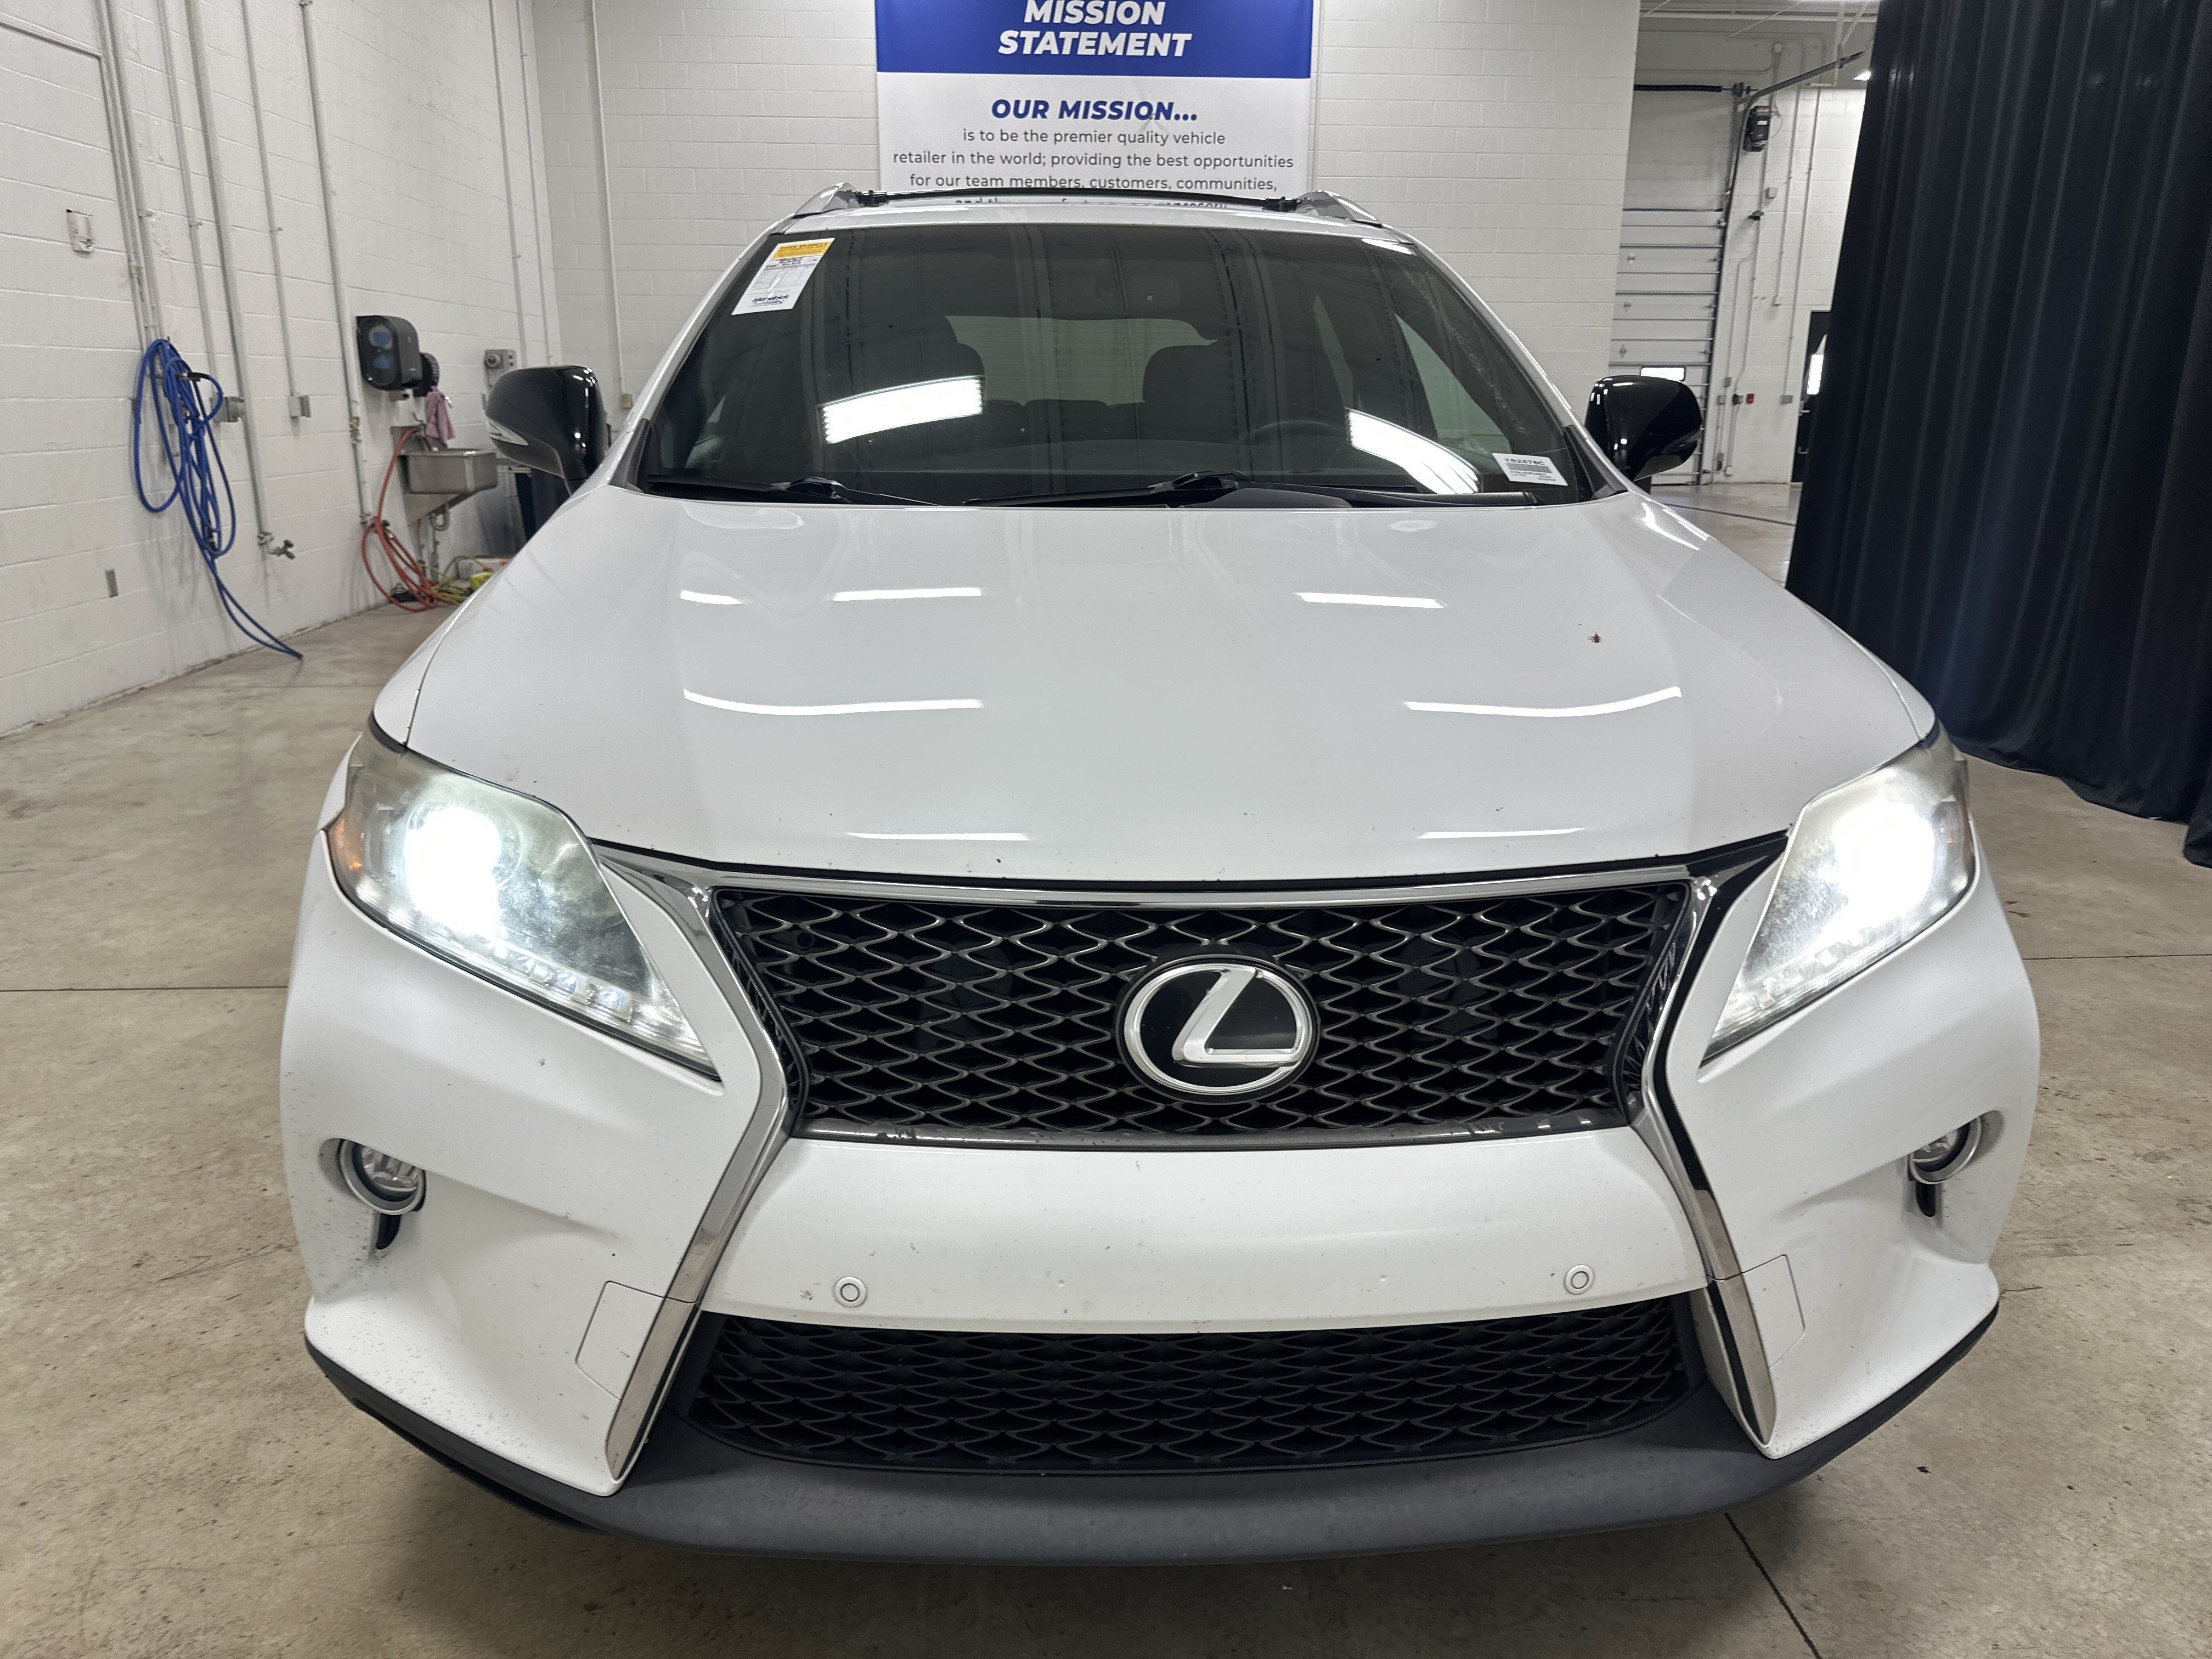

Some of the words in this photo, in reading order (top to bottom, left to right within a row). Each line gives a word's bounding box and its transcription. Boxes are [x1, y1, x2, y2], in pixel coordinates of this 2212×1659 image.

[1024, 0, 1166, 25] MISSION
[998, 30, 1193, 57] STATEMENT
[991, 99, 1049, 119] OUR
[1058, 100, 1197, 121] MISSION...
[963, 129, 975, 141] is
[980, 131, 995, 142] to
[1000, 129, 1019, 142] be
[1024, 129, 1048, 142] the
[1054, 130, 1113, 145] premier
[1118, 131, 1169, 146] quality
[1173, 132, 1225, 144] vehicle
[894, 151, 946, 163] retailer
[952, 151, 964, 163] in
[970, 151, 995, 164] the
[1000, 153, 1046, 166] world;
[1051, 153, 1121, 169] providing
[1126, 154, 1152, 166] the
[1156, 154, 1188, 167] best
[1193, 155, 1294, 170] opportunities
[910, 174, 930, 186] for
[935, 176, 960, 186] our
[966, 176, 1003, 187] team
[1090, 177, 1171, 190] customers,
[1176, 177, 1277, 192] communities,
